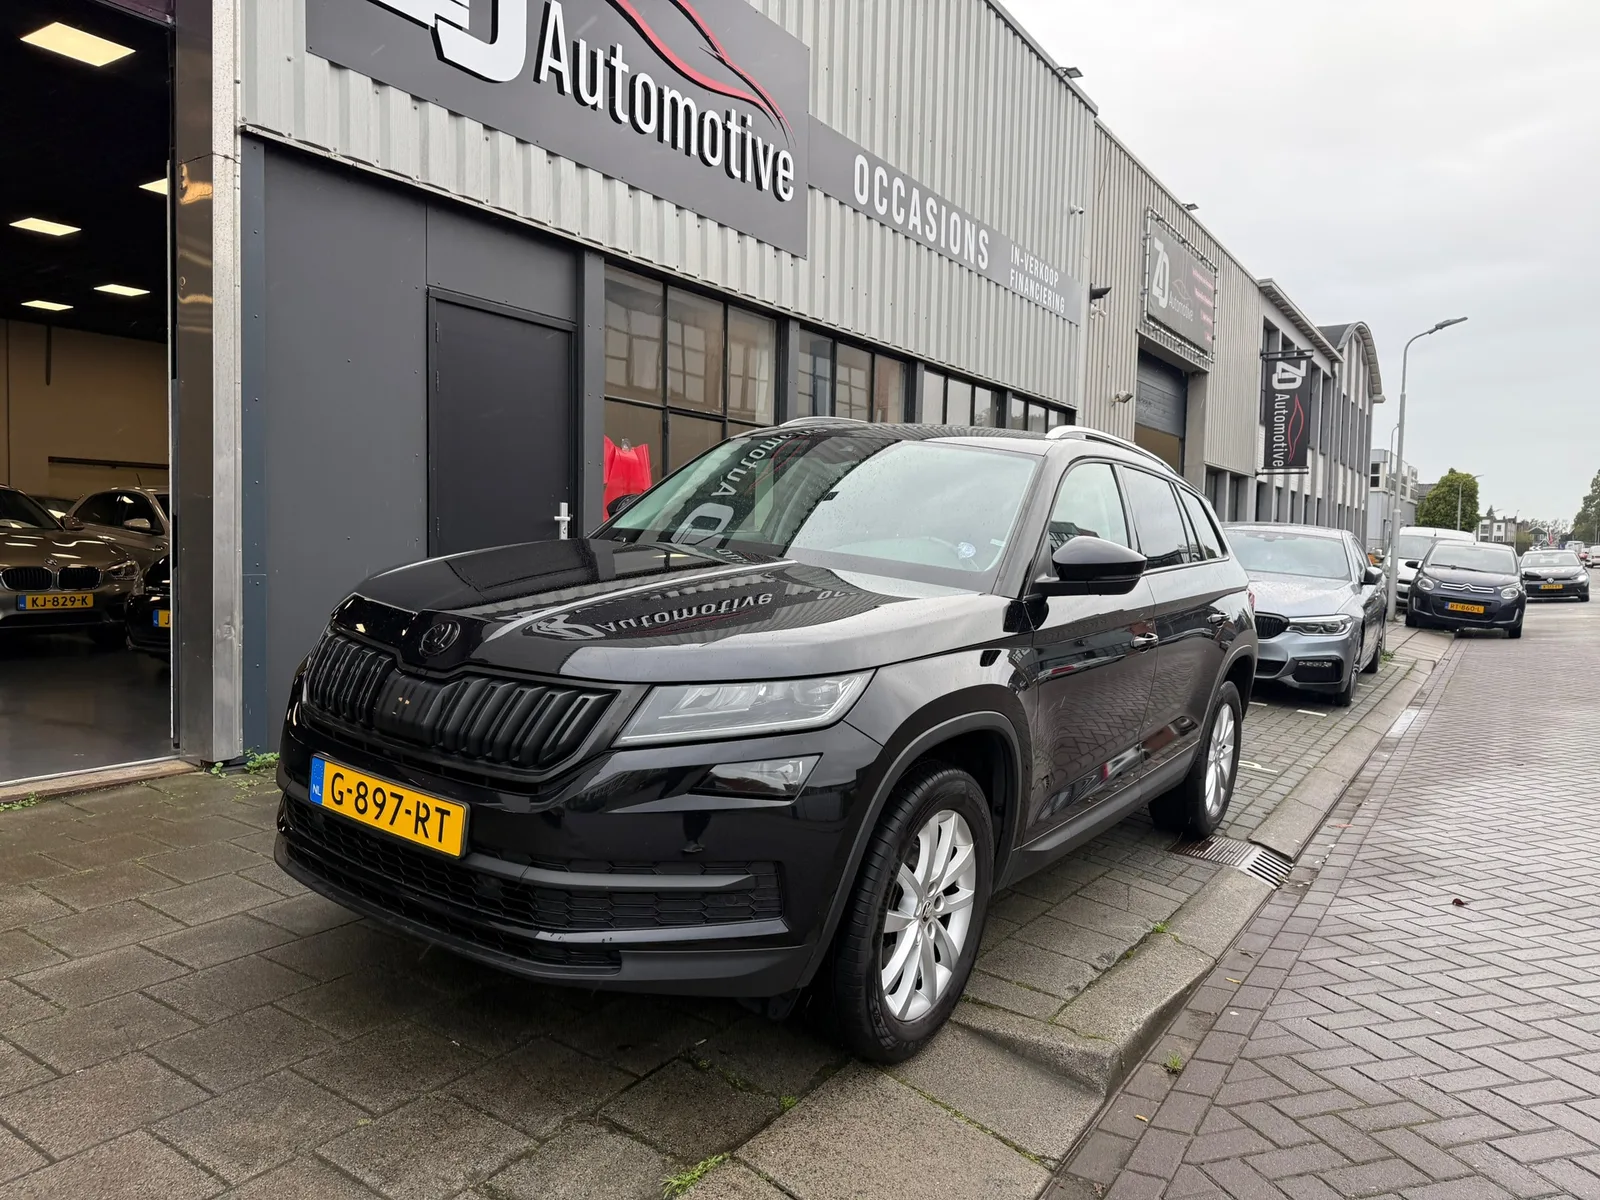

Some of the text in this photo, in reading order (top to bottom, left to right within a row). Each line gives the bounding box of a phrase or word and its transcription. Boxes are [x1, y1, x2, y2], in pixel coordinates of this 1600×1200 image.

[534, 0, 795, 202] Automotive
[854, 154, 989, 270] OCCASIONS
[1009, 267, 1065, 314] FINANCIERING
[1010, 244, 1059, 289] IN-VERKOOP
[1272, 393, 1290, 467] Automotive
[31, 595, 88, 608] KJ-829-K
[312, 772, 451, 843] NL G-897-RT
